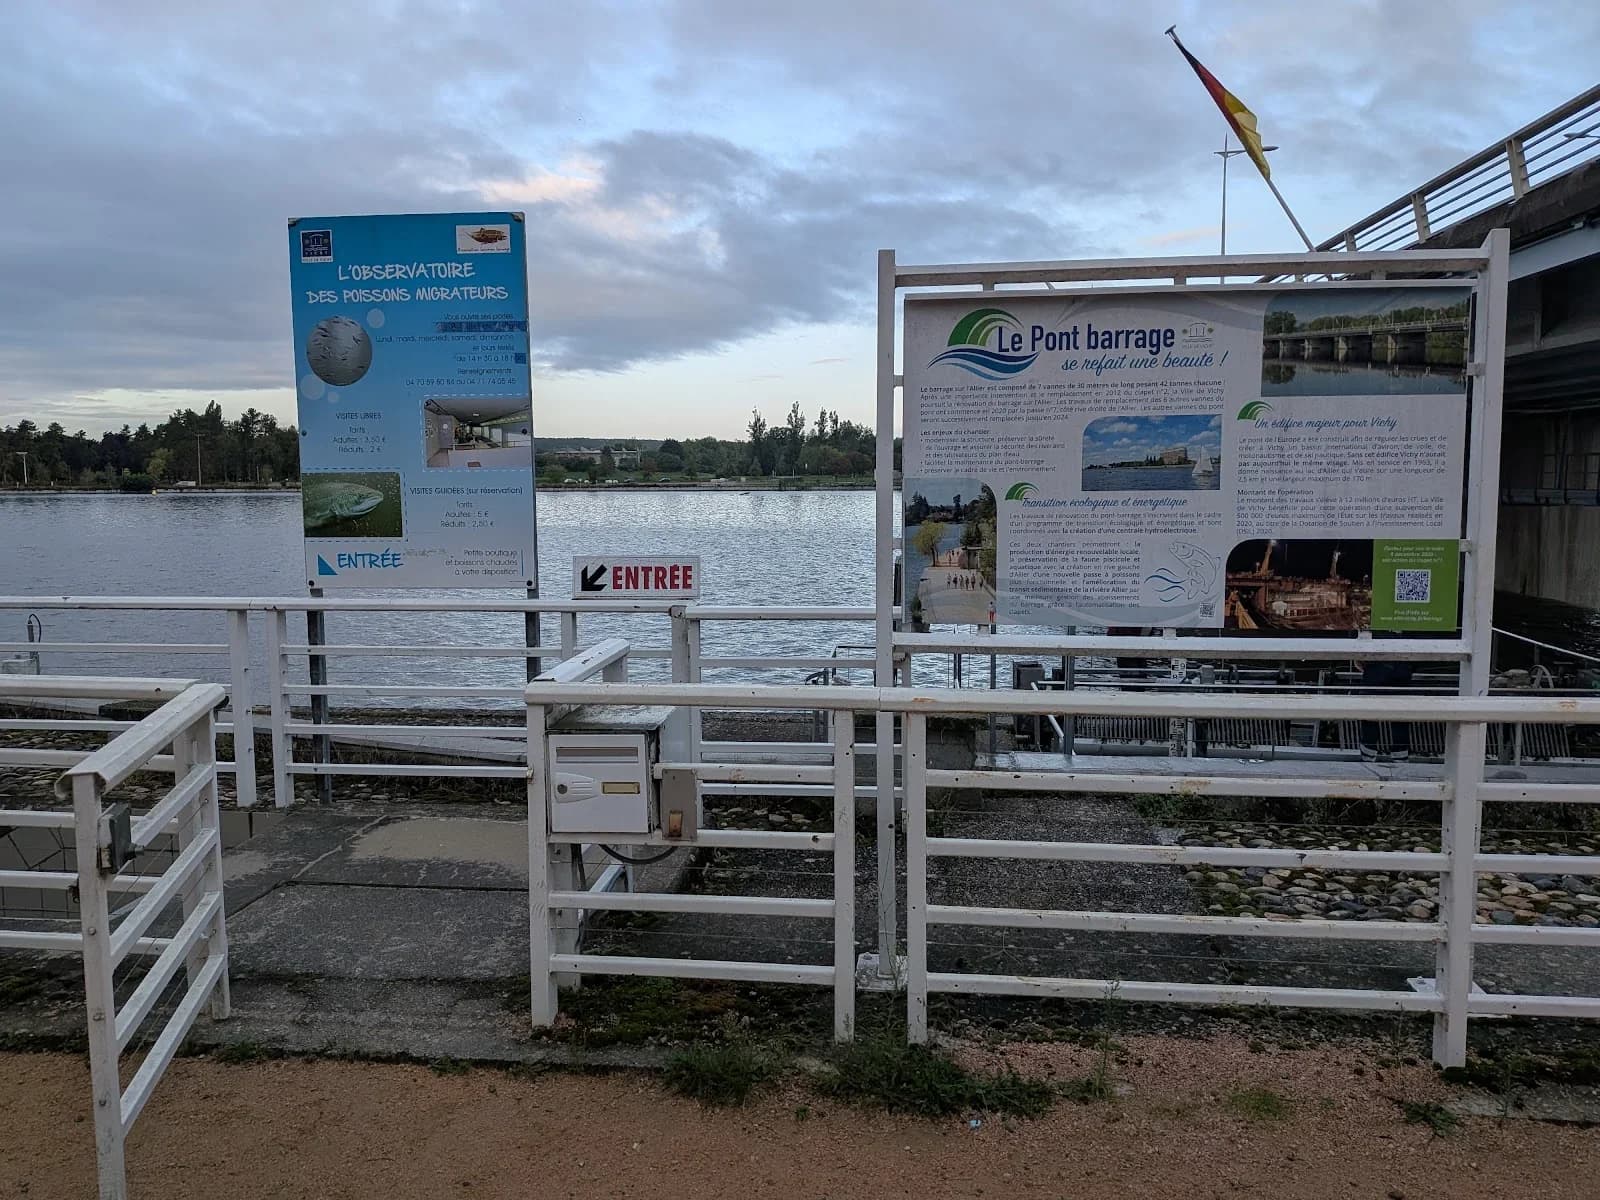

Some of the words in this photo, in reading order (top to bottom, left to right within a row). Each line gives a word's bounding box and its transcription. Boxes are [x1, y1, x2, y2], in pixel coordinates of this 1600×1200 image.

[338, 262, 476, 281] L'OBSERVATOIRE
[306, 290, 338, 304] DES
[344, 288, 411, 303] POISSONS
[416, 286, 508, 300] MIGRATEURS
[998, 326, 1022, 352] Le
[1032, 324, 1080, 351] Pont
[1087, 326, 1174, 356] barrage
[1061, 358, 1078, 370] se
[1082, 353, 1124, 376] refait
[1130, 358, 1158, 369] une
[1162, 352, 1214, 368] beauté
[1219, 351, 1228, 366] !
[336, 412, 358, 420] VISITES
[1272, 418, 1303, 432] édifice
[1306, 417, 1339, 431] majeur
[1341, 421, 1366, 430] pour
[1371, 417, 1396, 431] Vichy
[480, 487, 522, 496] réservation)
[1023, 497, 1066, 507] Transition
[1070, 496, 1116, 510] écologique
[1133, 496, 1187, 510] énergétique
[336, 548, 404, 568] ENTRÉE
[482, 568, 518, 577] disposition
[612, 564, 692, 590] ENTRÉE
